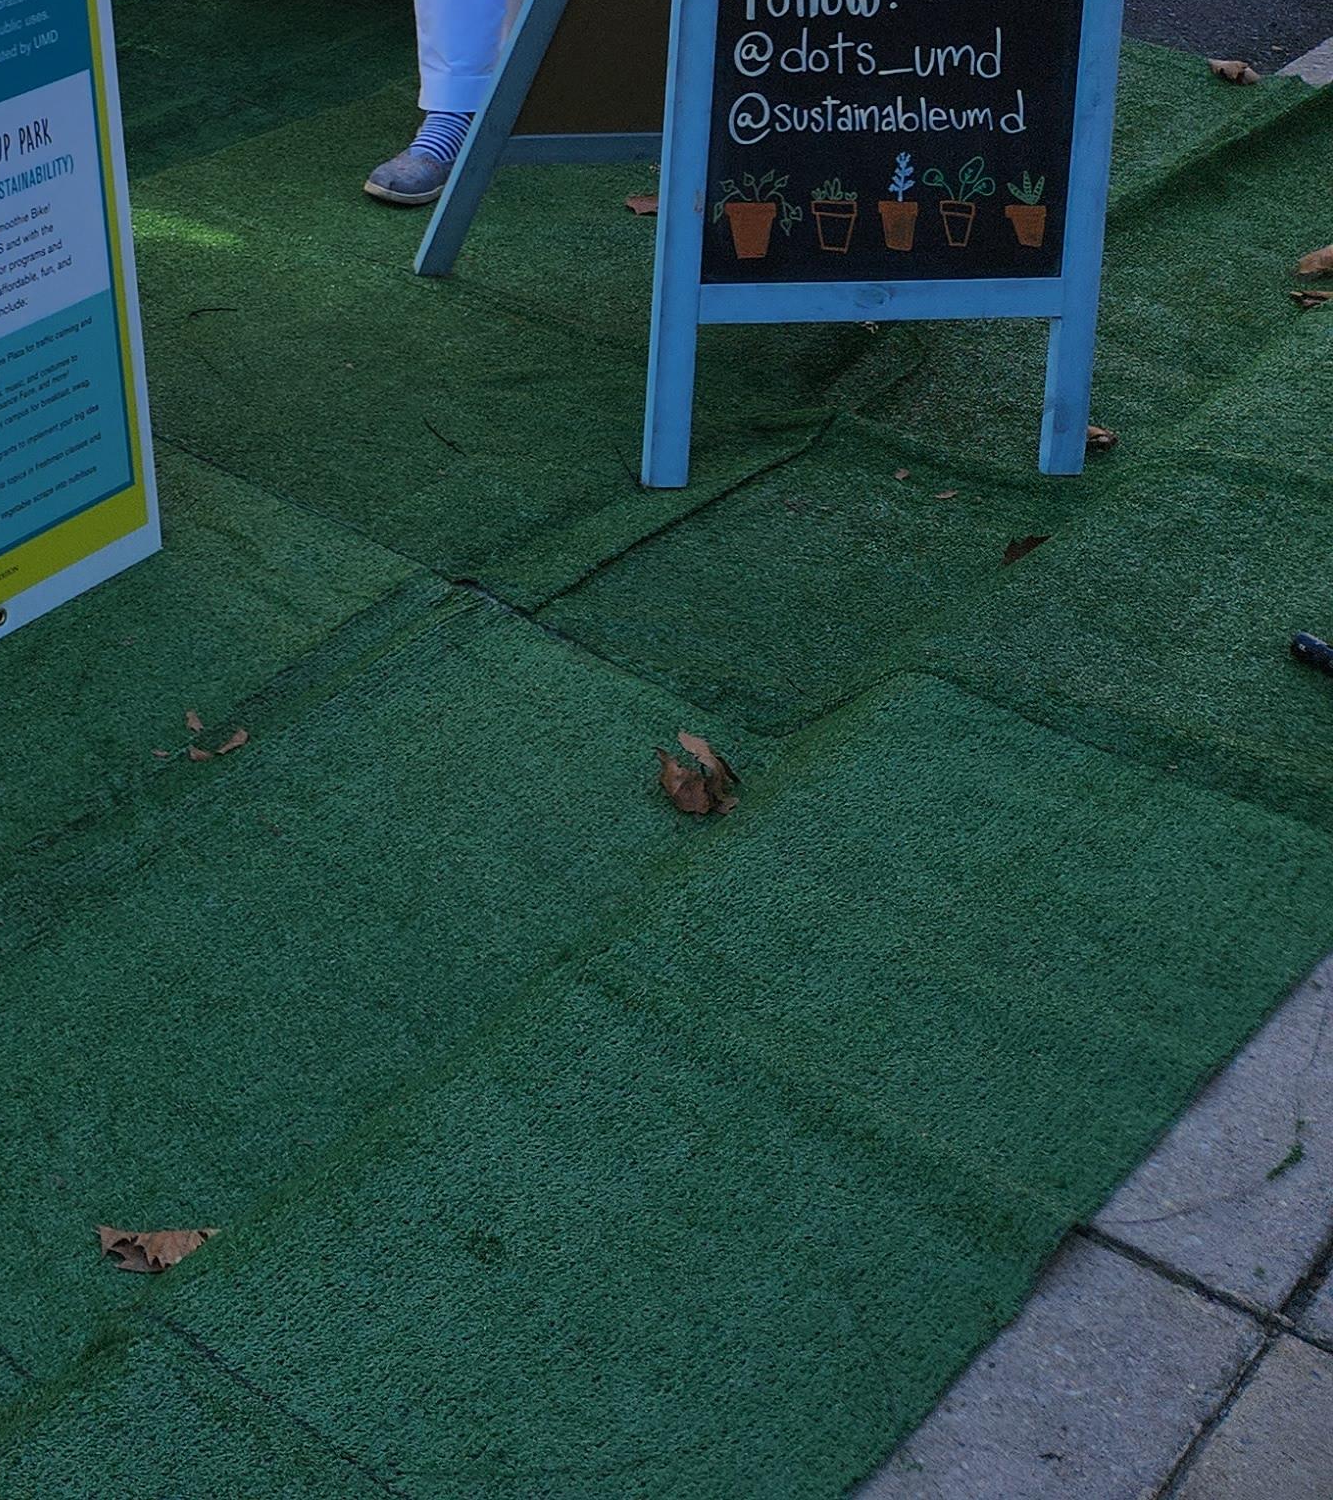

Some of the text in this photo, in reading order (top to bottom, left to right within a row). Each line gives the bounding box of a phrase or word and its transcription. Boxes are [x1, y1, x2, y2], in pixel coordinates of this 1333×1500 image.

[24, 9, 50, 26] uses.
[19, 38, 31, 58] by
[32, 28, 59, 49] UMD
[734, 27, 1002, 78] @dots_umd
[17, 116, 52, 154] PARK
[30, 201, 51, 220] Bike!
[5, 235, 21, 251] and
[22, 227, 40, 244] with
[40, 221, 54, 236] the
